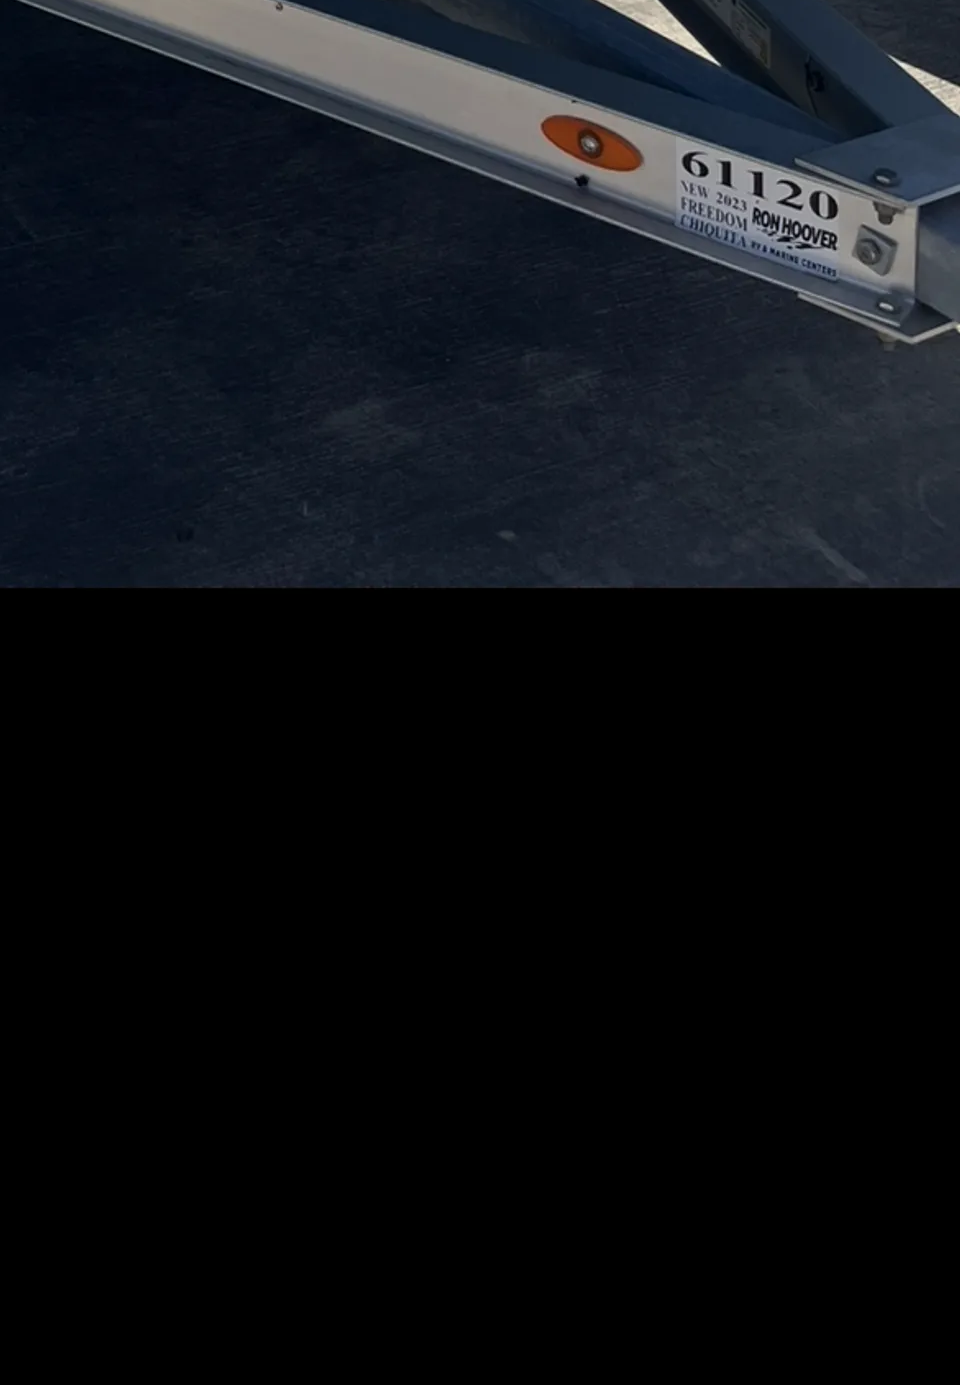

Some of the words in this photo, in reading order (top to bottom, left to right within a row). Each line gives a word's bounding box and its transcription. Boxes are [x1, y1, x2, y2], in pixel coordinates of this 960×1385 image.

[680, 180, 709, 199] NEW
[716, 192, 748, 211] 2023
[681, 151, 839, 220] 61120
[680, 214, 746, 248] CHIQUITA
[681, 197, 748, 231] FREEDOM
[752, 207, 780, 231] RON
[781, 217, 838, 250] HOOVER
[769, 248, 799, 265] MARINE
[801, 258, 837, 277] CENTERS
